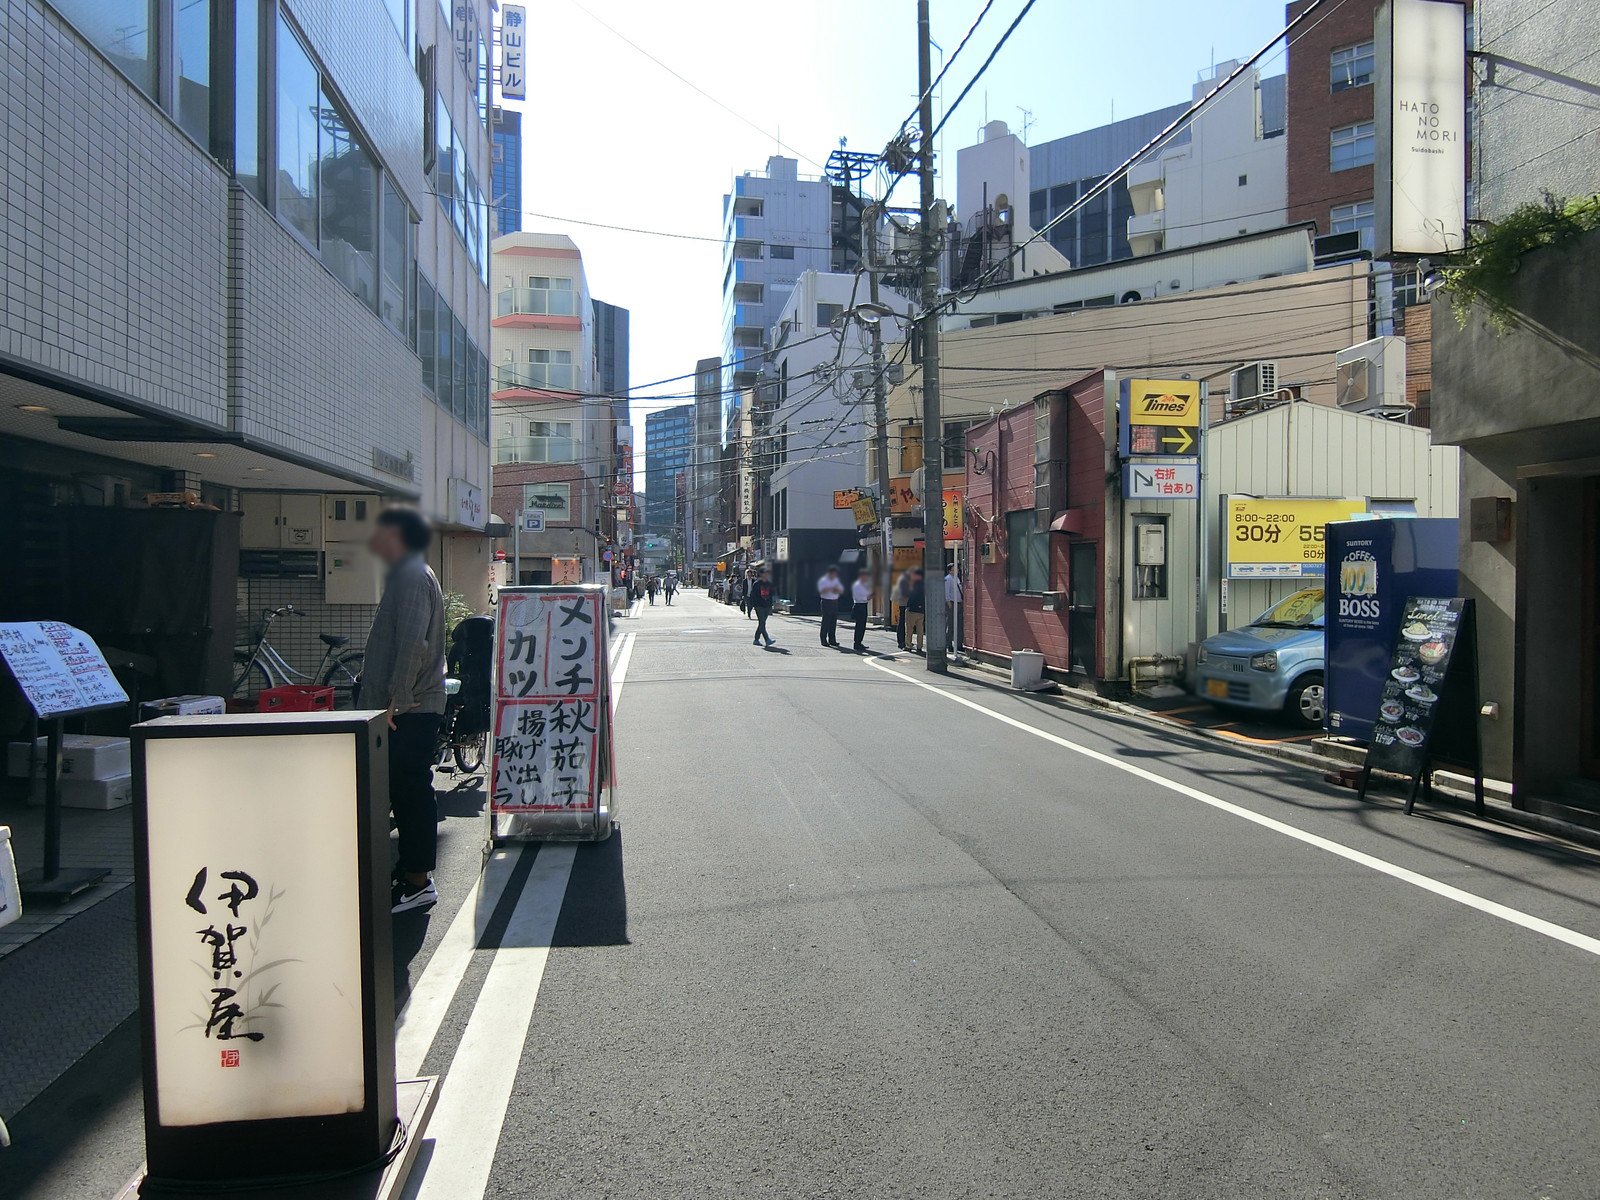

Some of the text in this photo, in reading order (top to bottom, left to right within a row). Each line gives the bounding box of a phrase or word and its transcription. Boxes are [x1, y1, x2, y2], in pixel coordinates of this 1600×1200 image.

[505, 11, 522, 87] 静山ビル
[1399, 100, 1439, 114] HATO
[1419, 116, 1439, 128] NO
[1416, 130, 1457, 142] MORI
[1411, 146, 1444, 154] Suidobashi
[1142, 394, 1190, 412] Times
[1154, 468, 1175, 480] 右折
[1156, 483, 1193, 494] 1台あり
[529, 520, 538, 528] P
[1235, 514, 1295, 522] 8:00～22:00
[1303, 550, 1324, 559] 60分
[1339, 599, 1380, 618] BOSS
[1407, 607, 1440, 621] Lunch
[554, 596, 593, 695] メンチ
[508, 631, 537, 698] カツ
[516, 710, 546, 806] 揚げ出し
[549, 699, 597, 806] 秋茄子
[493, 735, 518, 806] 豚バラ
[185, 866, 265, 1042] 伊賀屋
